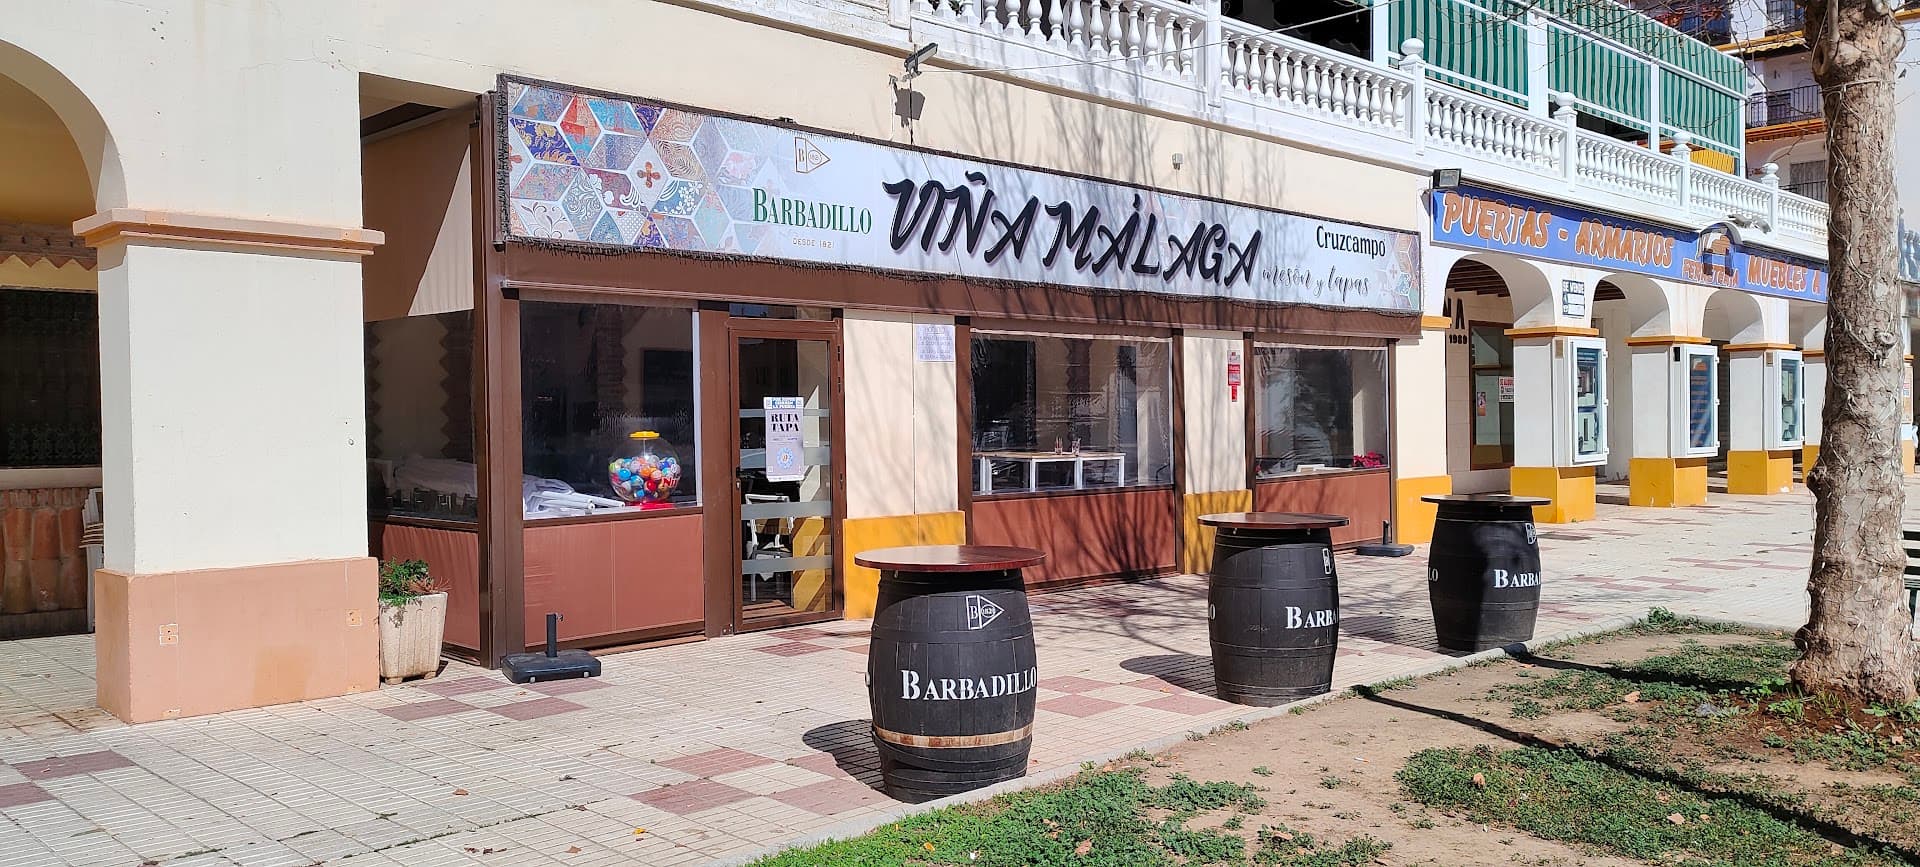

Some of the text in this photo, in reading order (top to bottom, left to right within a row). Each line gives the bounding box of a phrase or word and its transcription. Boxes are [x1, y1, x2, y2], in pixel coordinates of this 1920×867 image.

[882, 171, 1263, 286] VIÑA MÁLAGA
[1441, 190, 1551, 249] PUERTAS
[1575, 218, 1675, 268] ARMARIOS
[793, 238, 816, 247] DESDE
[1316, 225, 1386, 260] Cruzcampo
[1262, 264, 1370, 304] mesón y tapas
[1747, 255, 1808, 292] MUEBLES
[771, 413, 800, 422] RUTA
[771, 423, 800, 432] TAPA
[1493, 568, 1540, 588] BARBA
[970, 605, 979, 619] B
[1285, 606, 1339, 629] BARBA
